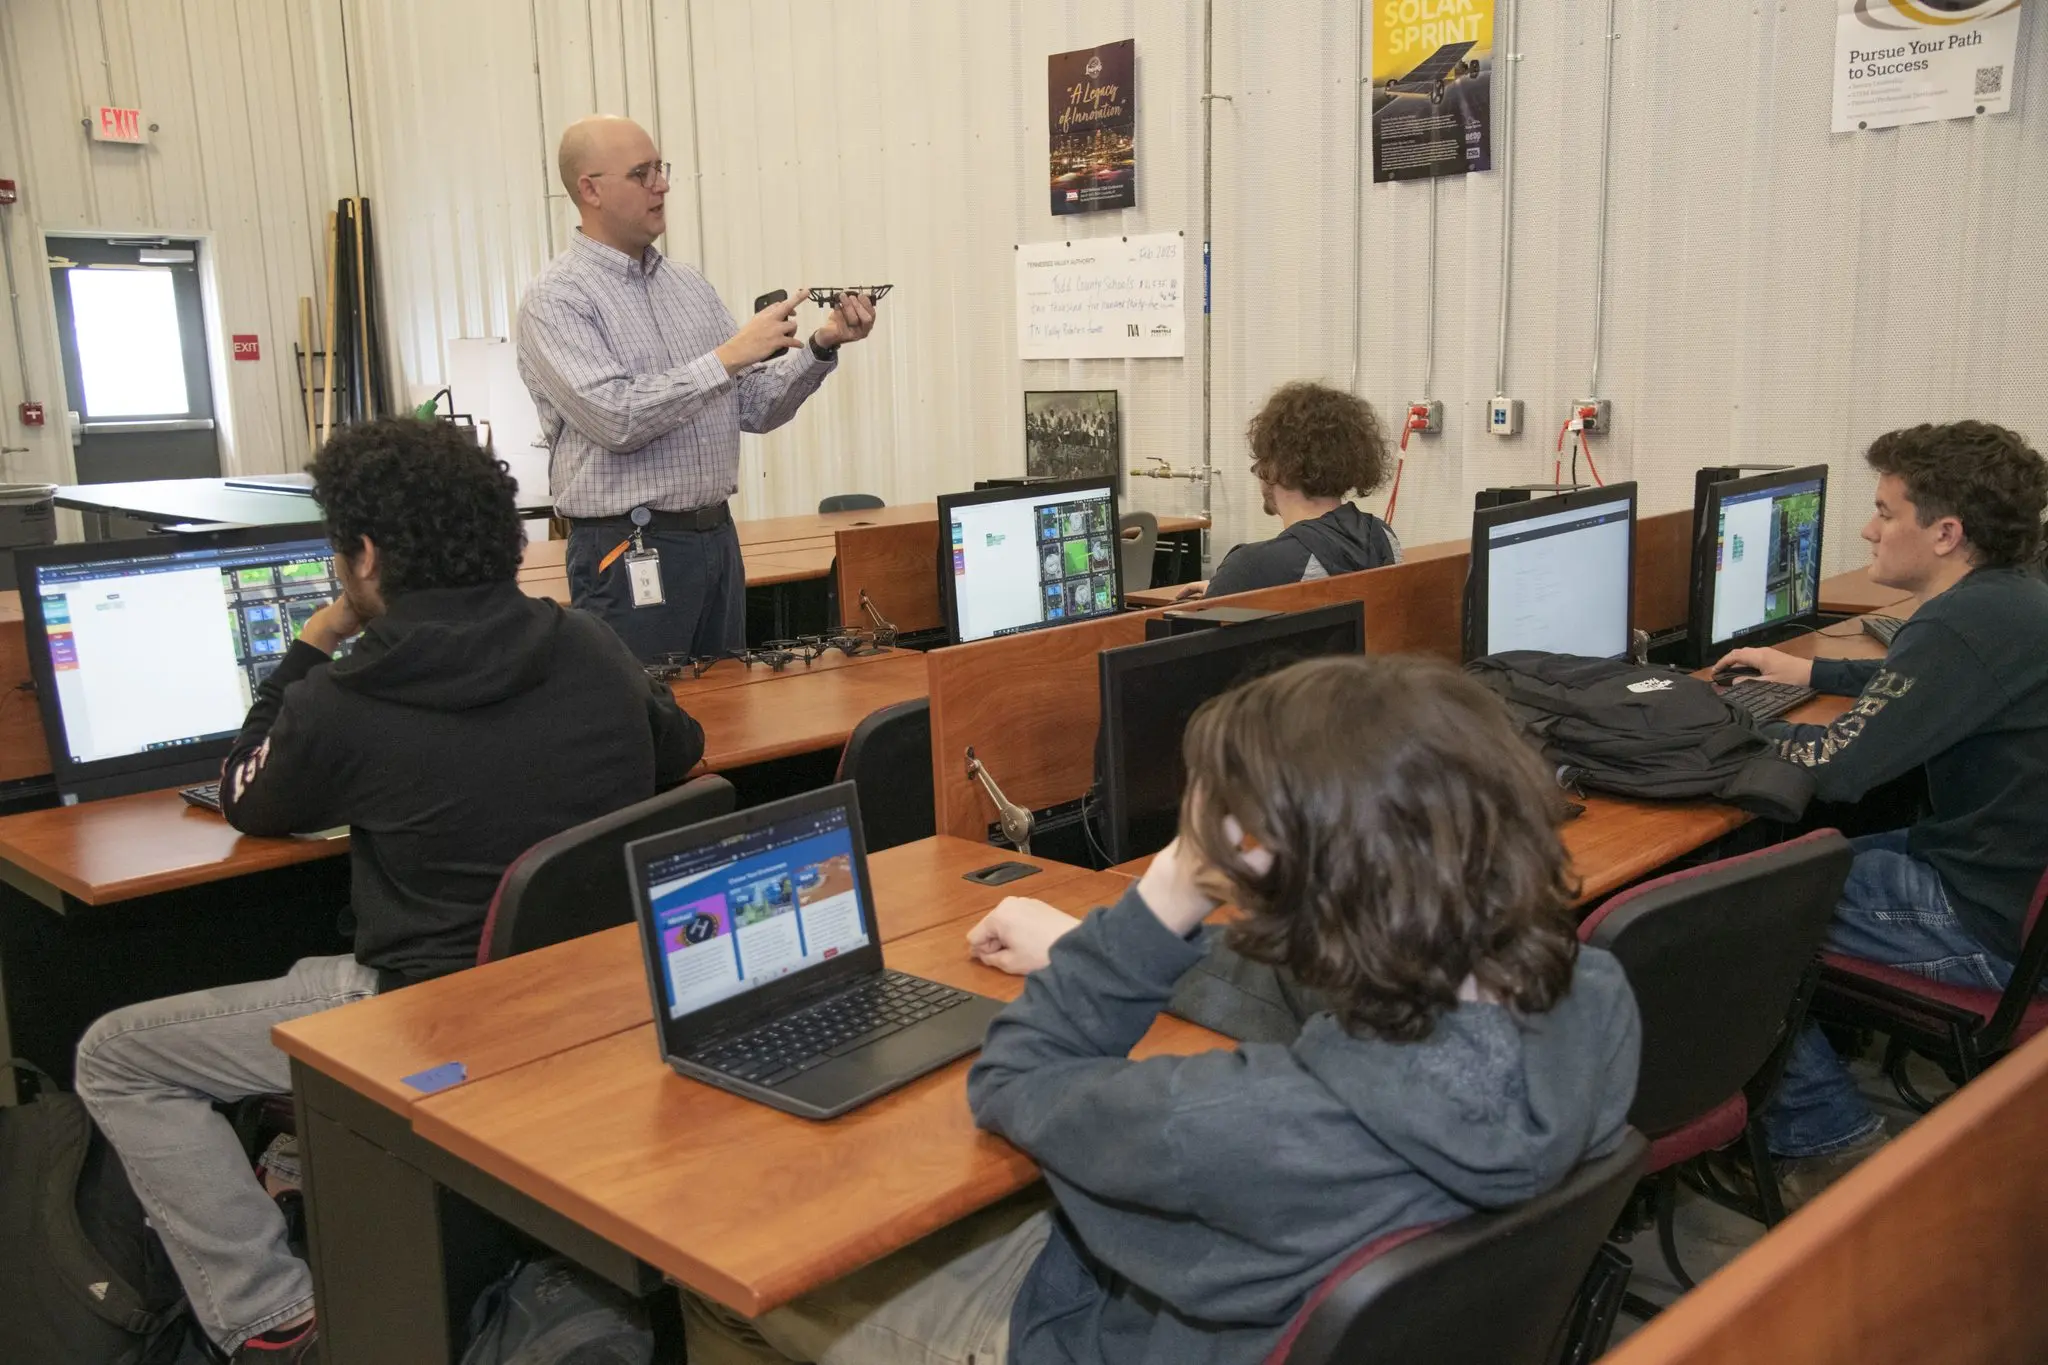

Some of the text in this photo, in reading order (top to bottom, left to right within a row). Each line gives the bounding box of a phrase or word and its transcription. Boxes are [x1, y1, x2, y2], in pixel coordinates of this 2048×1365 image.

[1388, 12, 1484, 55] SPRINT
[1849, 31, 1982, 64] Pursue Your Path
[1849, 59, 1929, 80] to Success
[1083, 82, 1118, 109] Legacy
[100, 108, 140, 140] EXIT
[1059, 106, 1071, 133] of
[1127, 324, 1140, 337] TVA
[234, 342, 258, 353] EXIT
